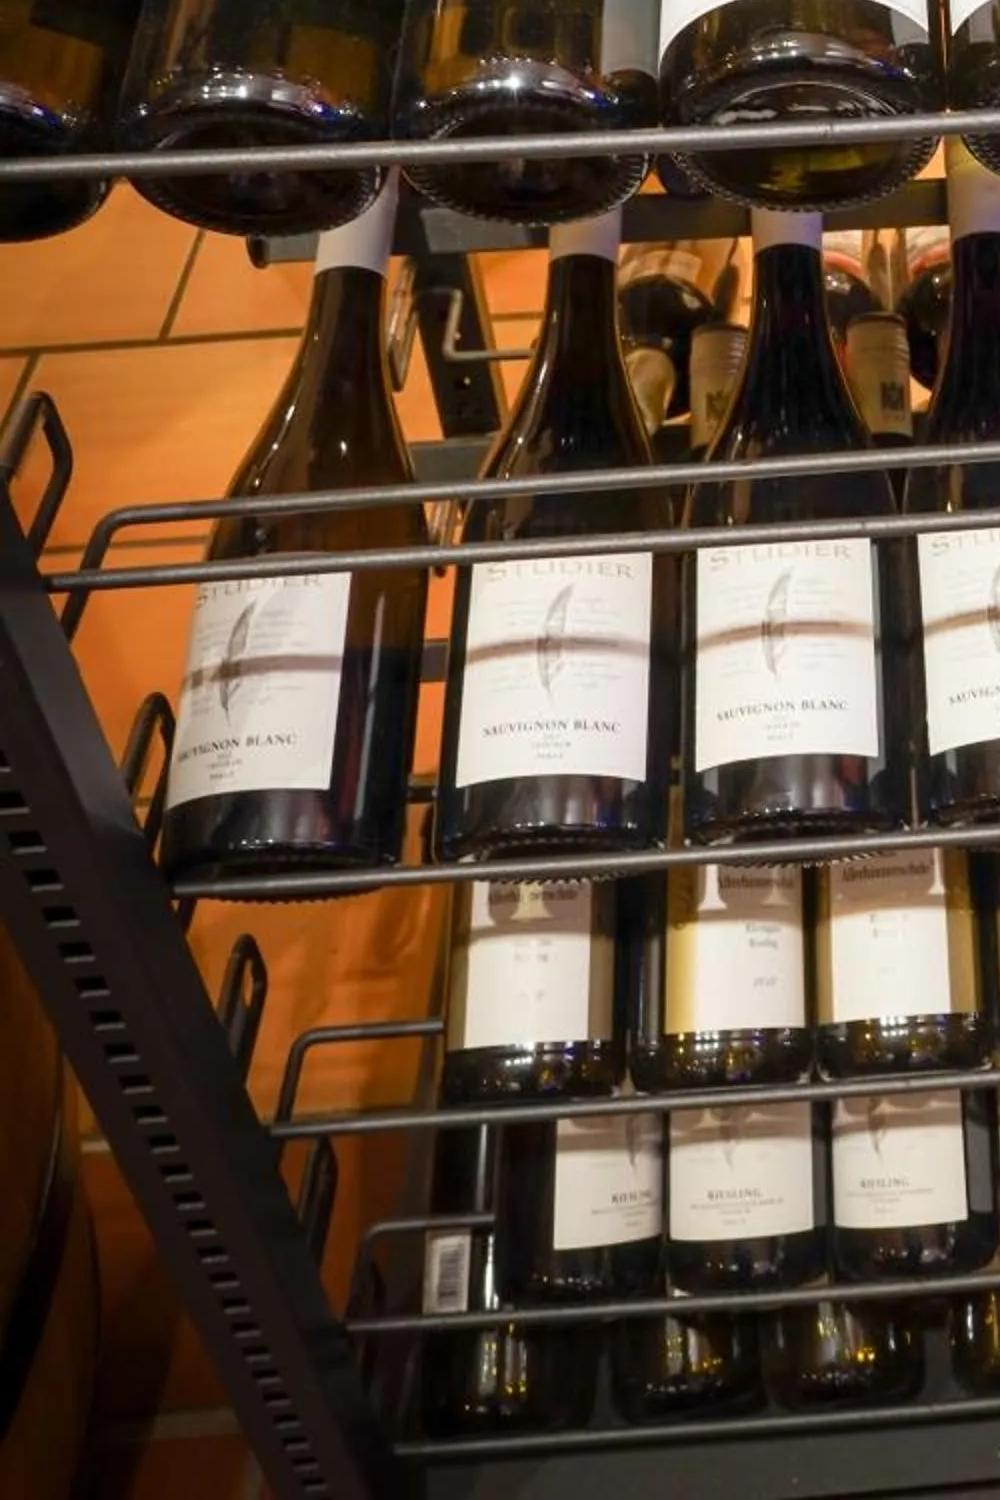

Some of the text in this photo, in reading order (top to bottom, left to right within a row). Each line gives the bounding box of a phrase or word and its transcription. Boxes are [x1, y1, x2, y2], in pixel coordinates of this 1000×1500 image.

[716, 698, 848, 721] SAUVIGNON BLANC
[482, 718, 621, 739] SAUVIGNON BLANC
[245, 733, 298, 750] BLANC
